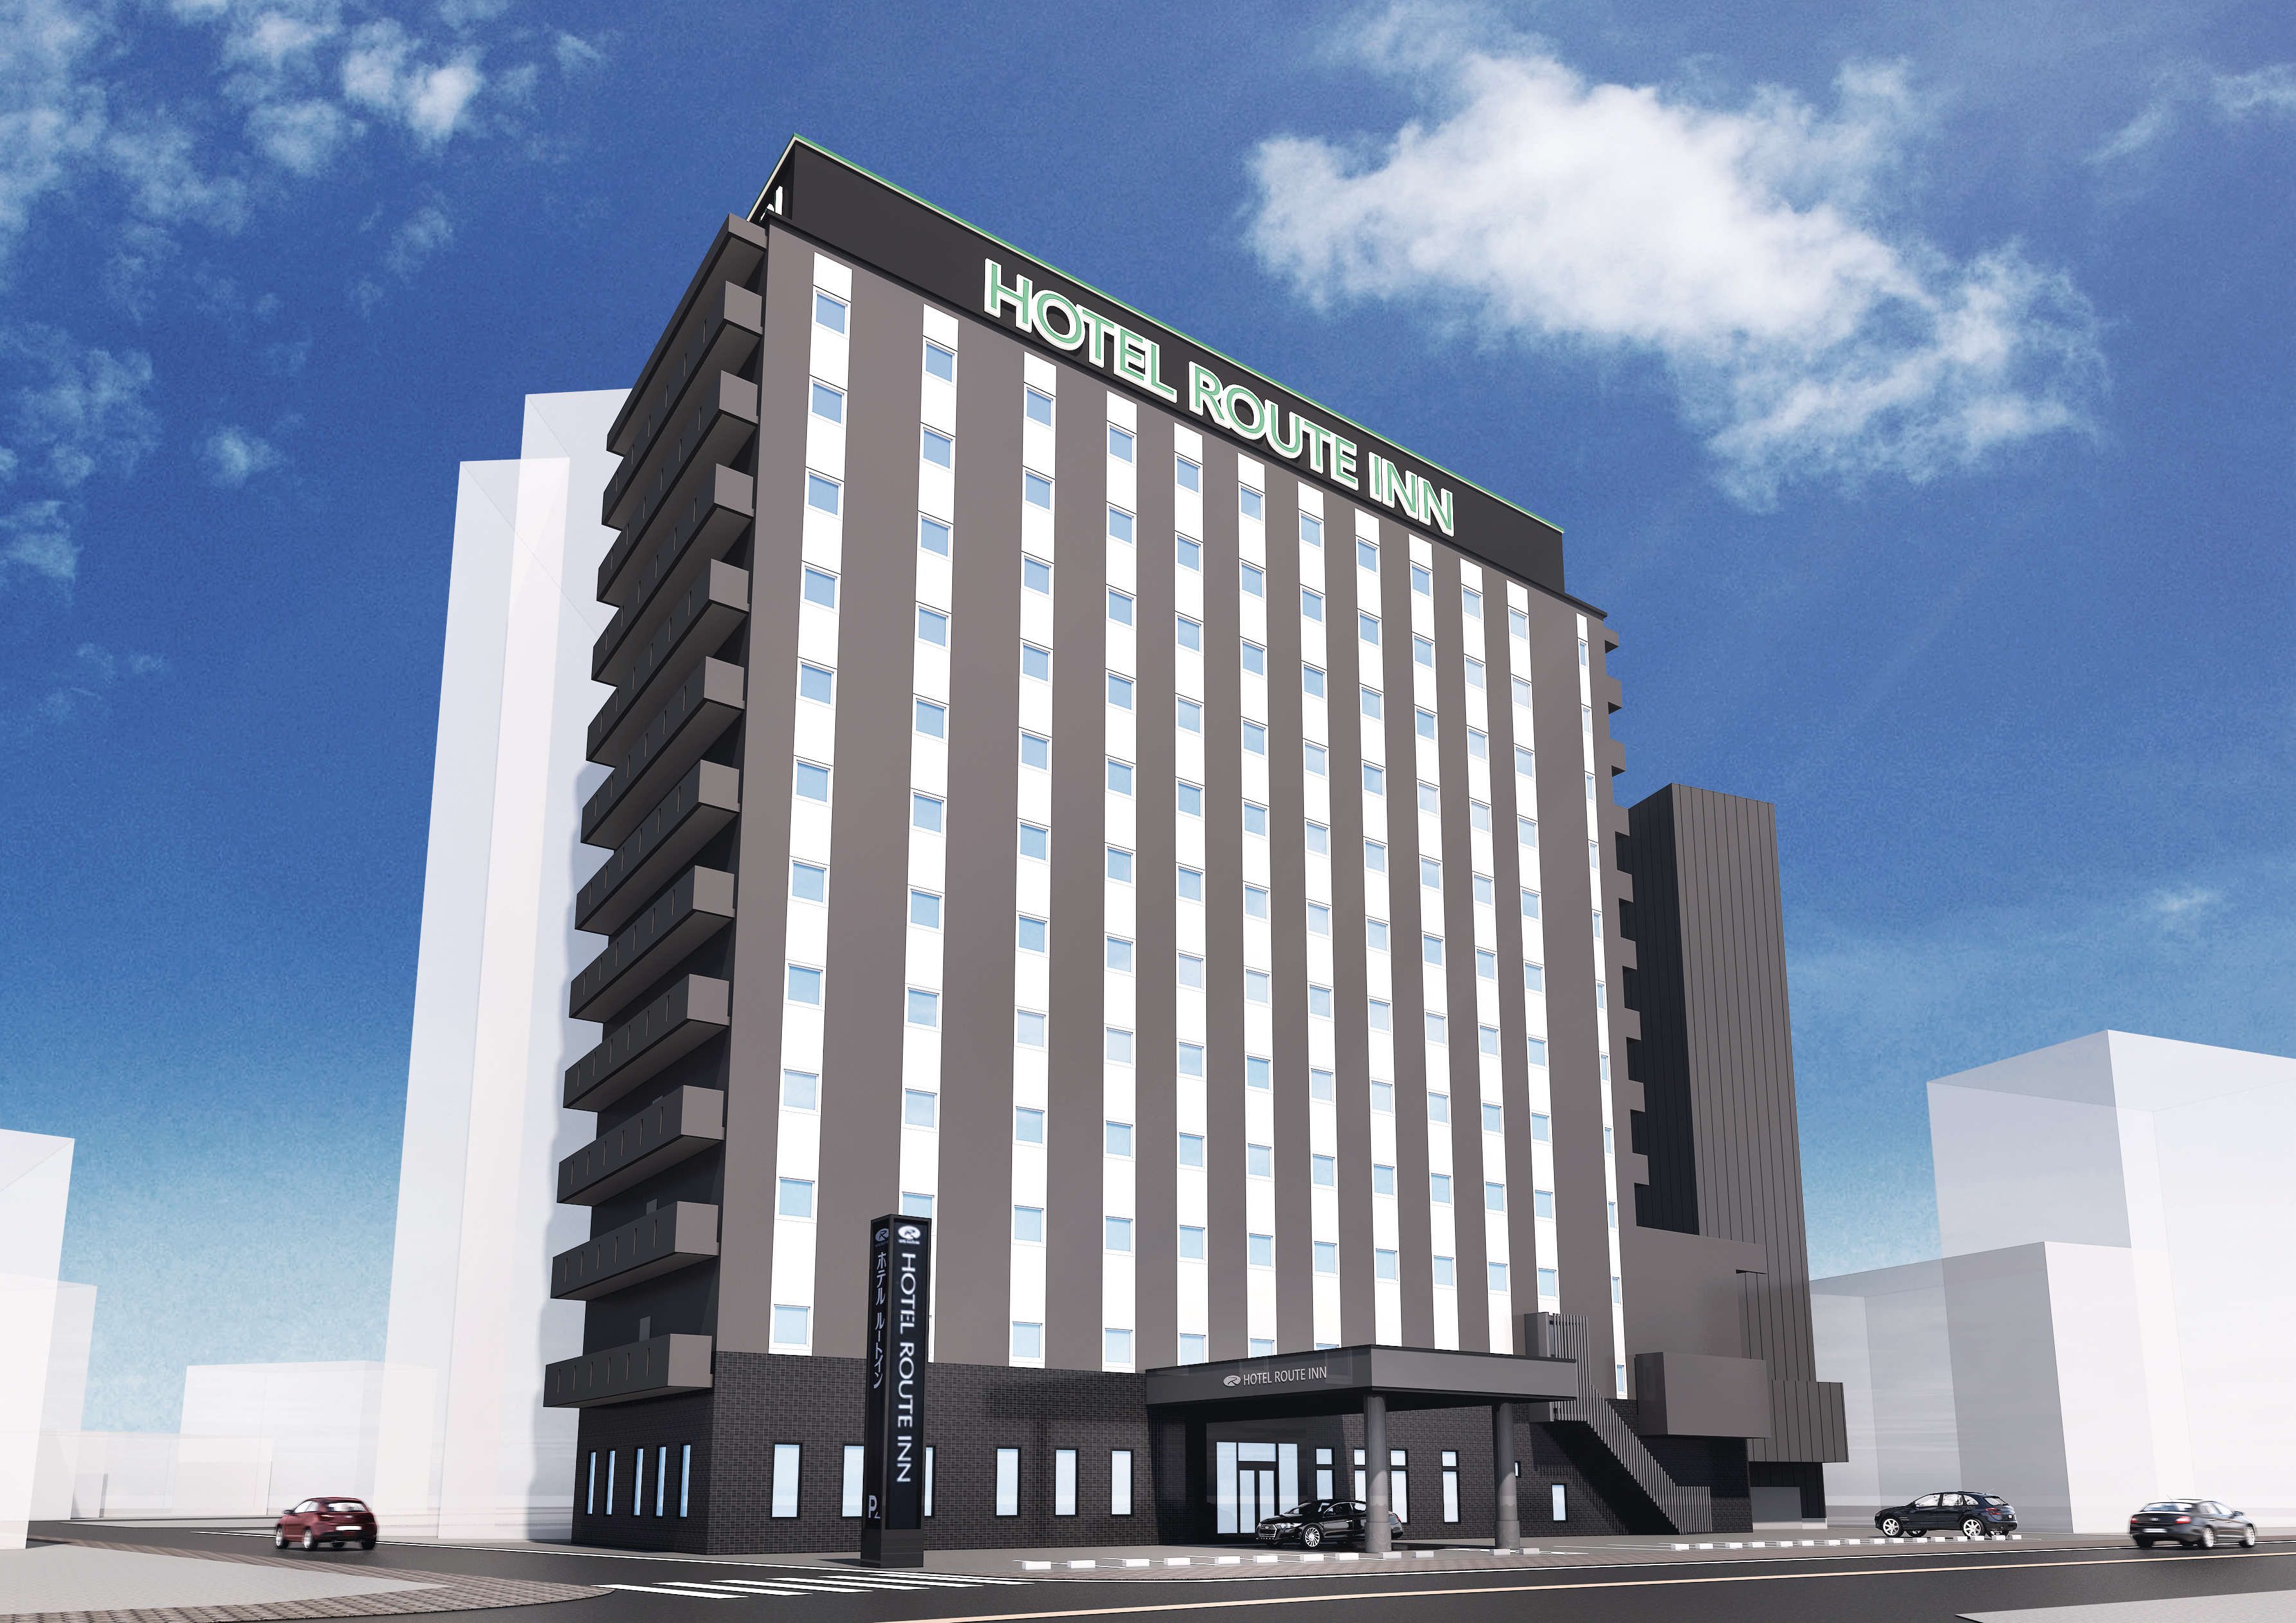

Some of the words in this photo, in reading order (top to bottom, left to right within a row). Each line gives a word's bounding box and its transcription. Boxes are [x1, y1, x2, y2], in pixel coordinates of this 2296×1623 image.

[984, 258, 1177, 404] HOTEL
[1189, 361, 1359, 491] ROUTE
[1368, 451, 1455, 537] INN
[875, 1251, 887, 1306] ホテル
[900, 1252, 916, 1334] HOTEL
[873, 1312, 885, 1389] ルートイン
[1243, 1372, 1272, 1386] HOTEL
[1274, 1368, 1306, 1383] ROUTE
[1308, 1366, 1328, 1380] INN
[898, 1342, 914, 1428] ROUTE
[896, 1435, 912, 1482] INN
[868, 1494, 878, 1518] P
